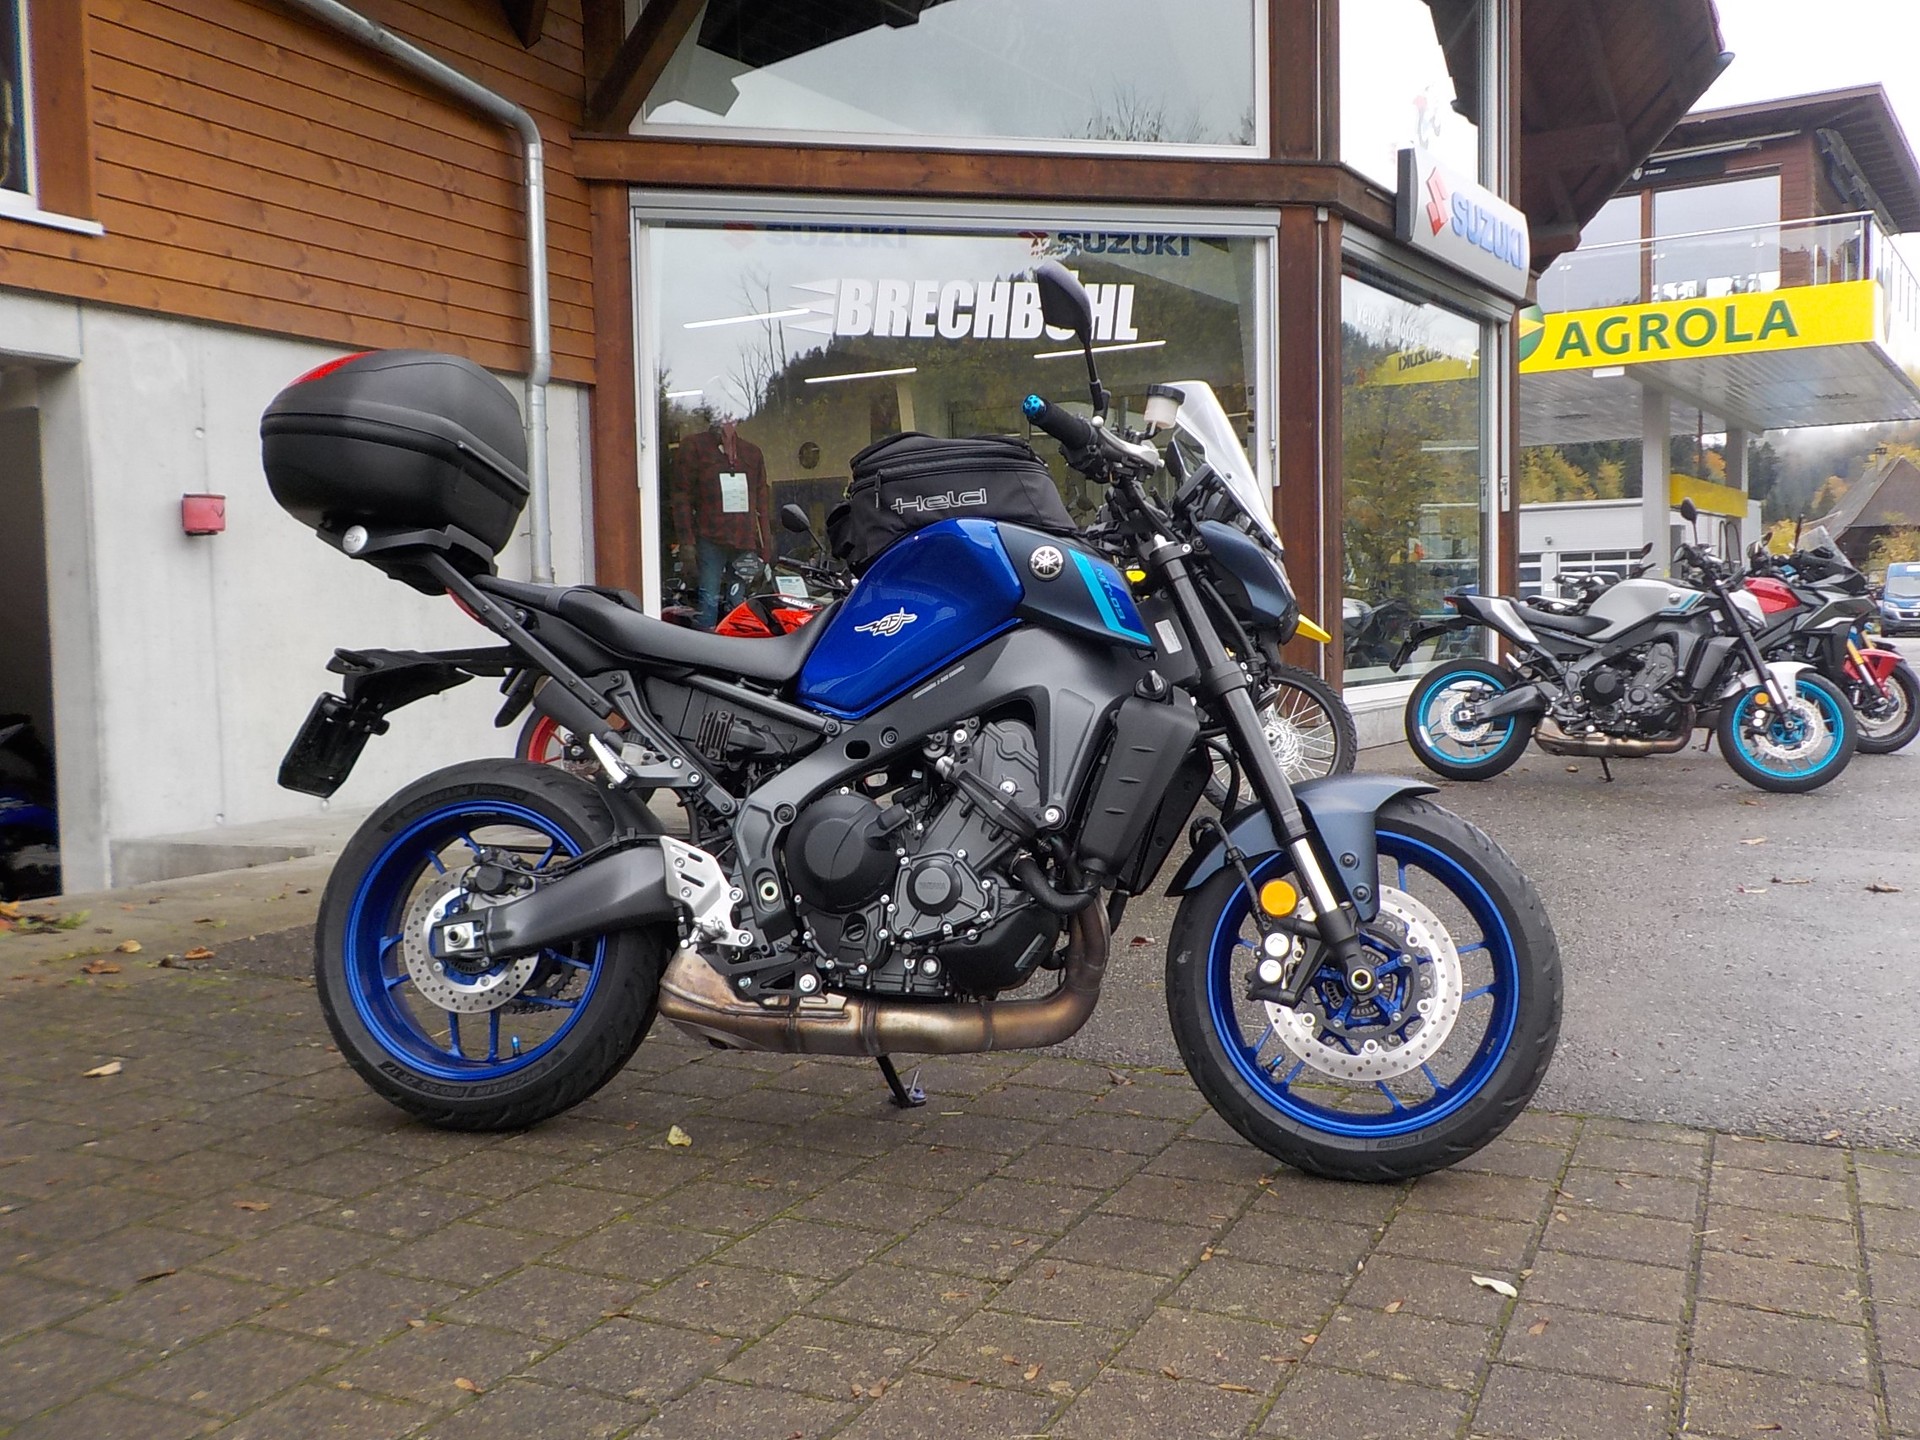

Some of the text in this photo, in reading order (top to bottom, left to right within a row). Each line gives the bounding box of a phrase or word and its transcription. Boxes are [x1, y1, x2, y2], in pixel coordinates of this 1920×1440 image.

[1058, 232, 1190, 256] SUZUKI
[1451, 191, 1524, 271] SUZUKI
[836, 271, 1138, 341] BRECHBHL
[1555, 299, 1799, 361] AGROLA
[890, 488, 987, 514] Held
